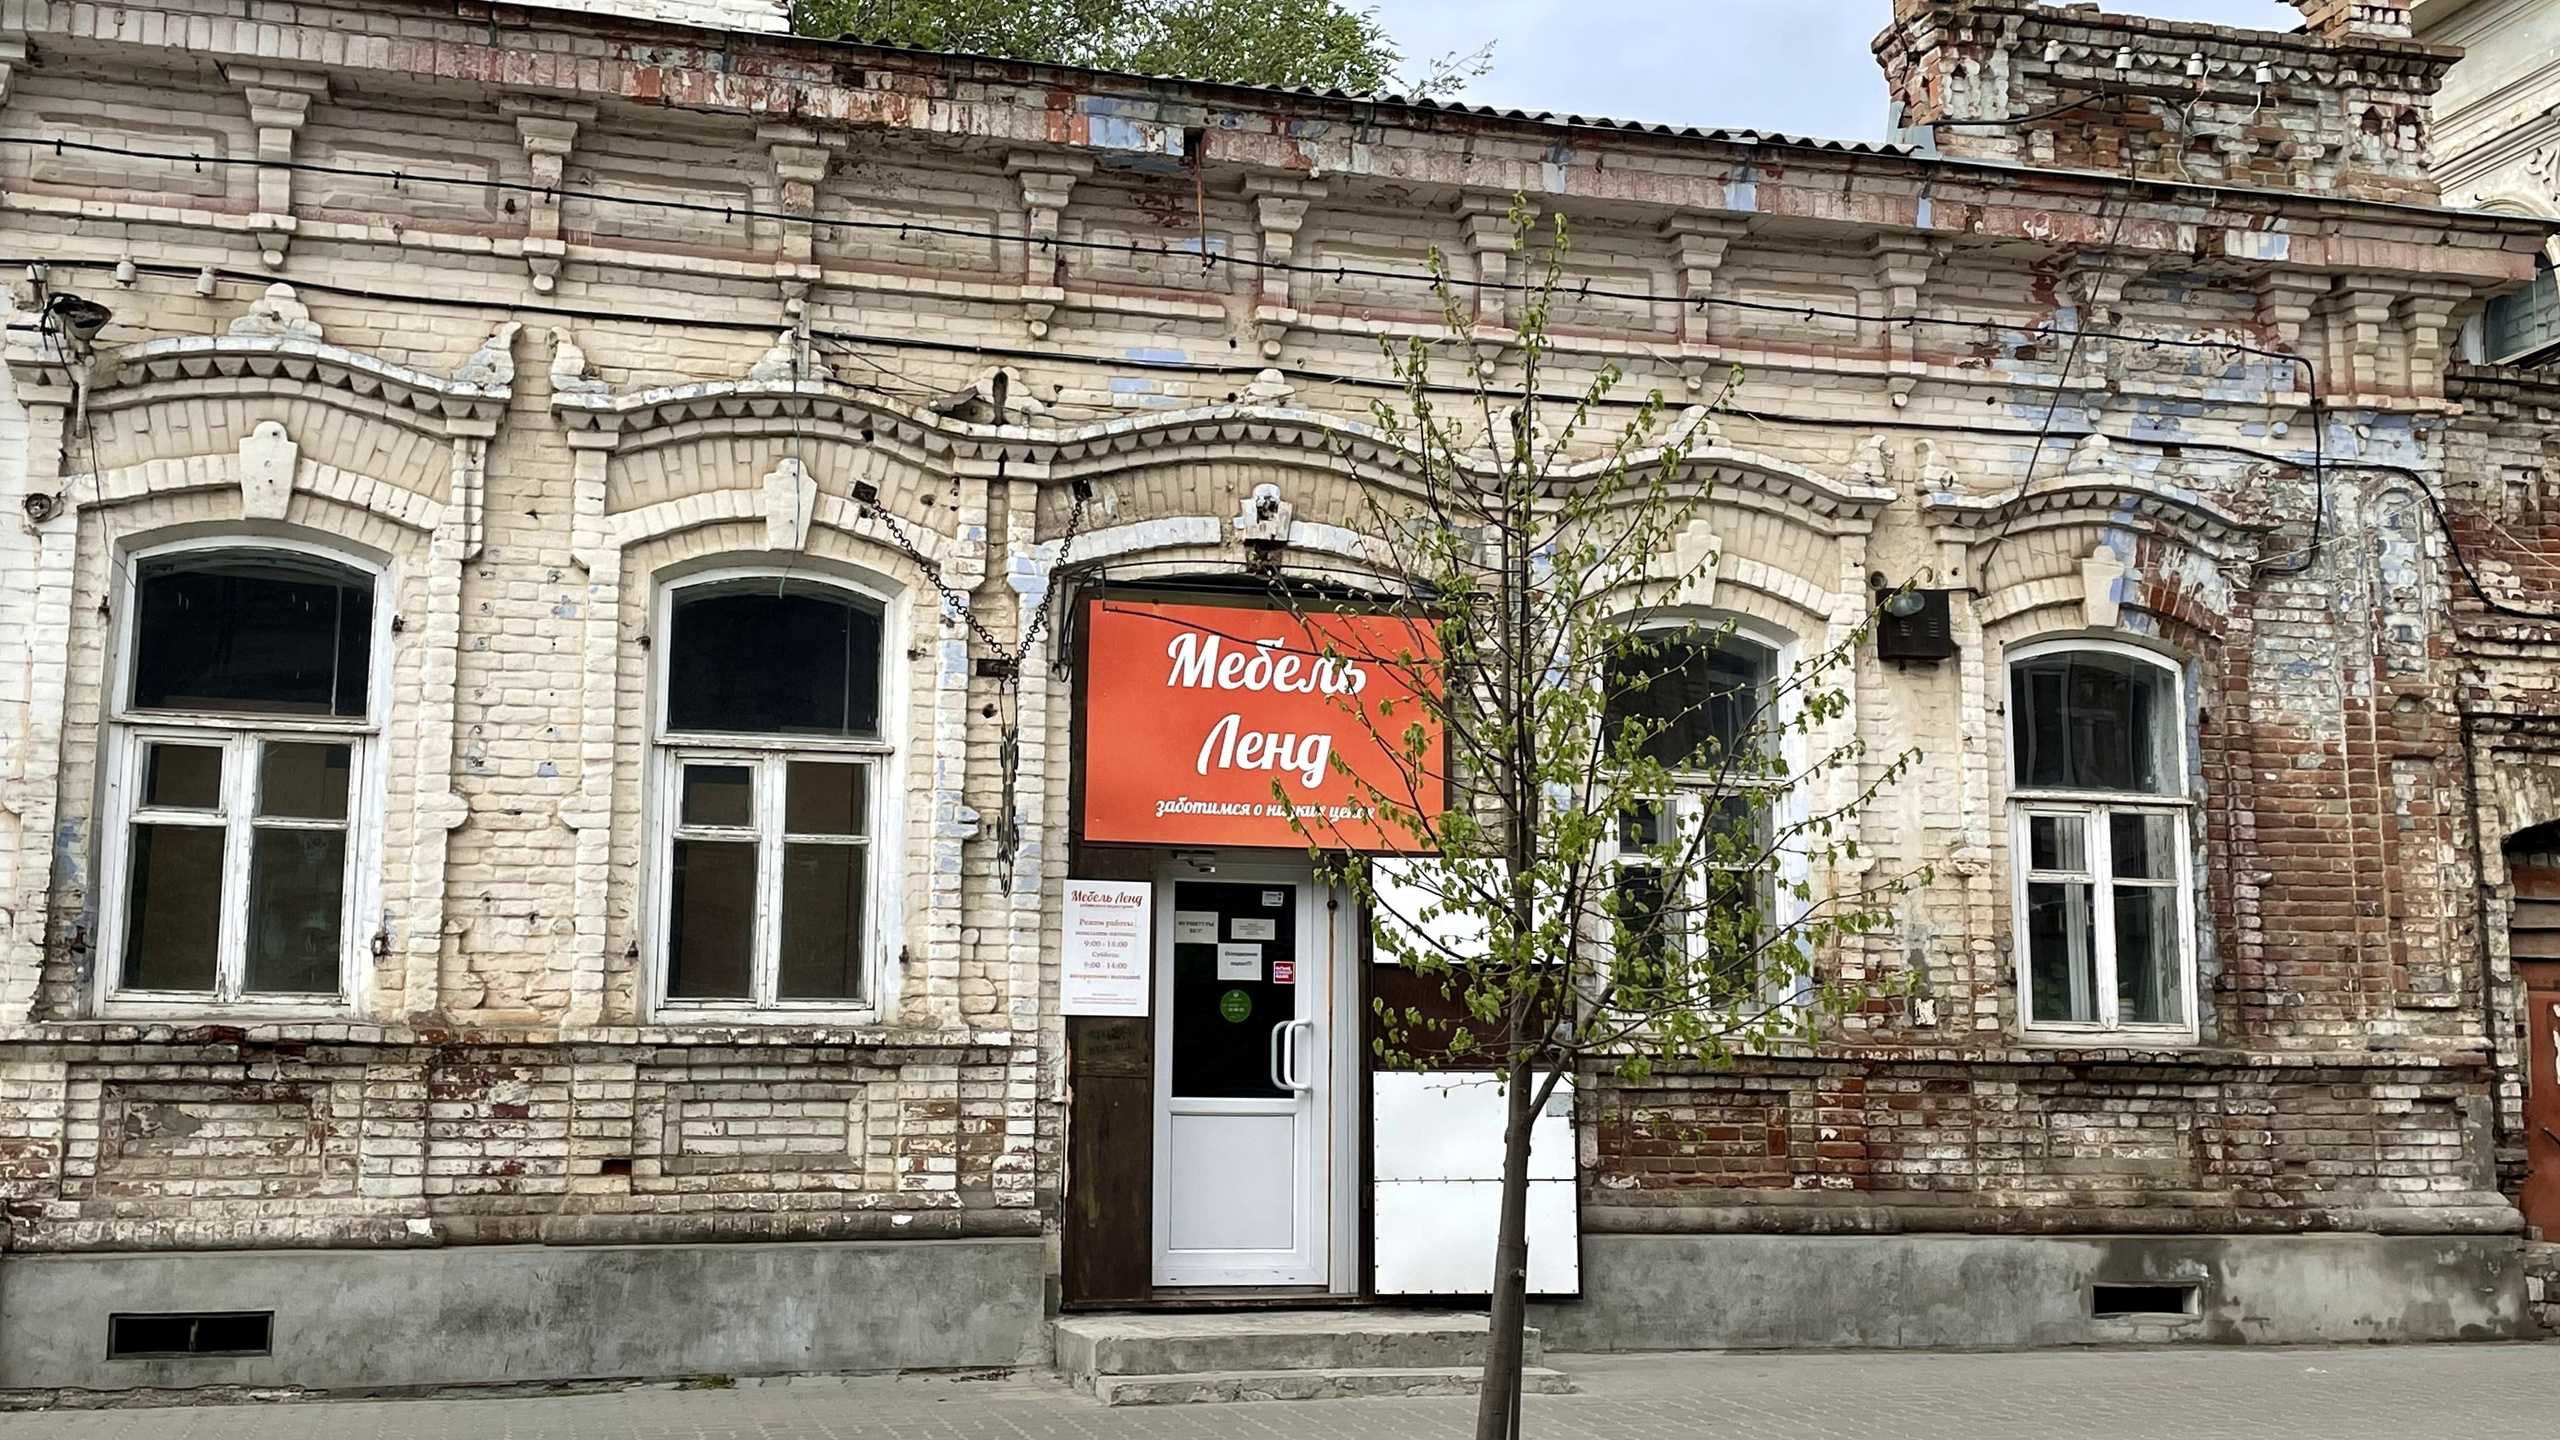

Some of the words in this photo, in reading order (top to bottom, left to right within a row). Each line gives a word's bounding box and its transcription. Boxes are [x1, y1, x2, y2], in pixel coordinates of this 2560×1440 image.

[1167, 632, 1367, 695] Мебель
[1196, 713, 1332, 789] Ленд
[1155, 796, 1251, 817] заботимся
[1253, 804, 1263, 816] о
[1071, 890, 1113, 903] Мебель
[1114, 891, 1143, 908] Ленд
[1105, 918, 1134, 929] работы
[1083, 939, 1102, 948] 9:00
[1083, 961, 1101, 970] 9:00
